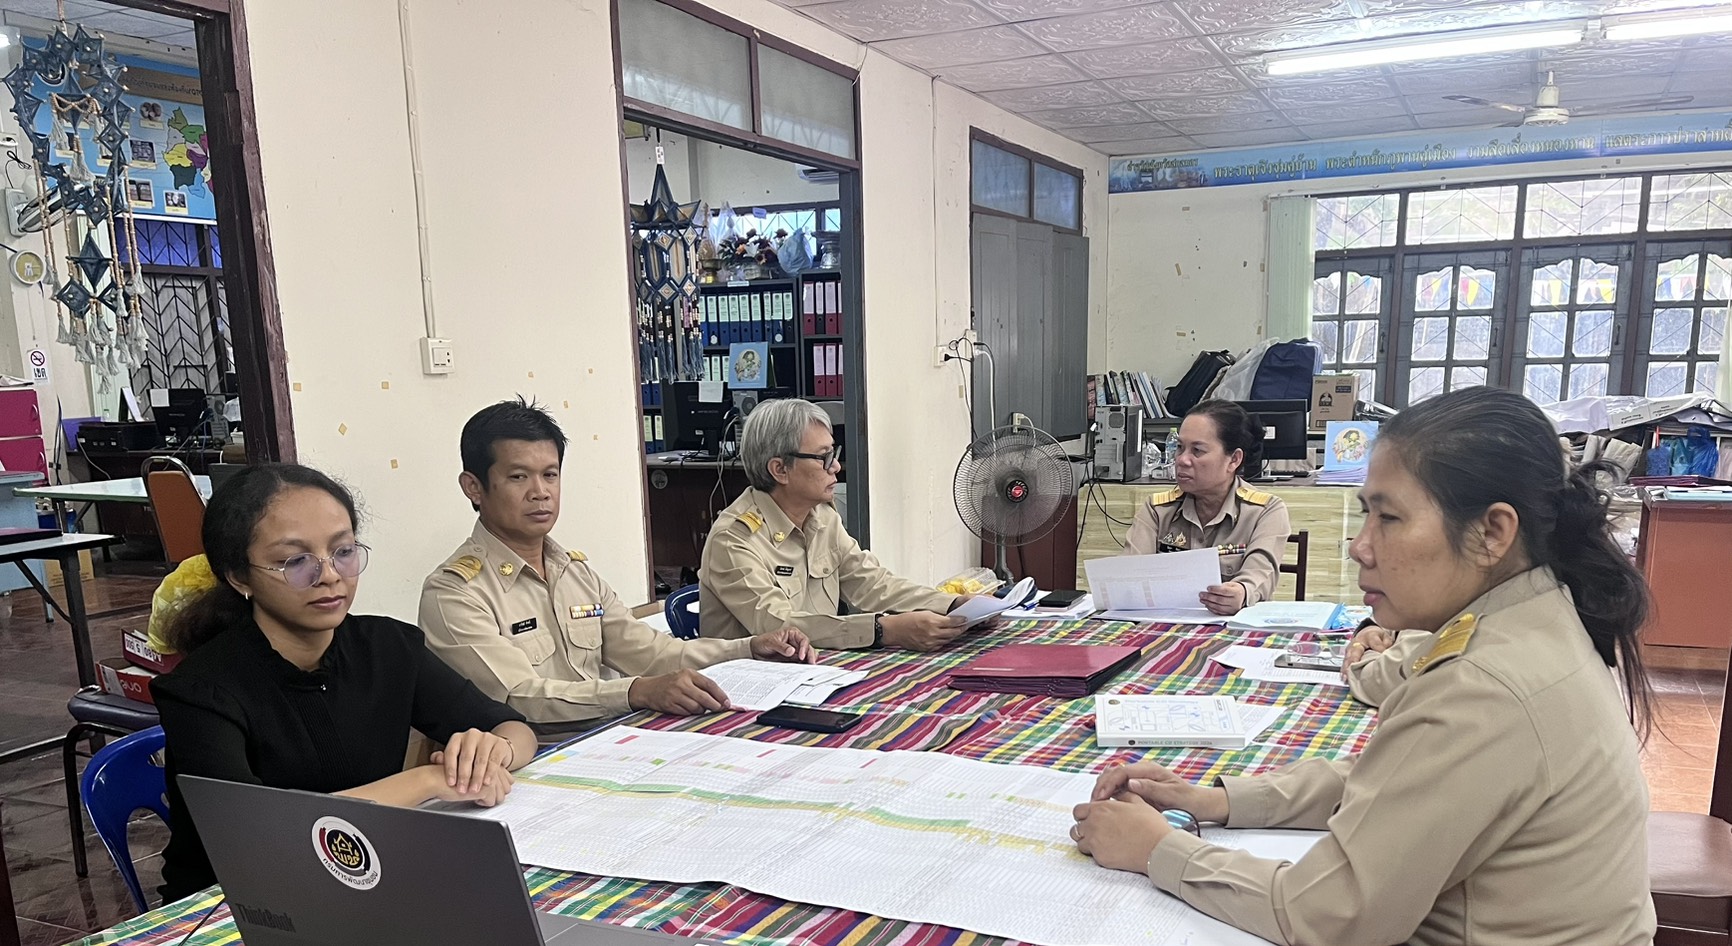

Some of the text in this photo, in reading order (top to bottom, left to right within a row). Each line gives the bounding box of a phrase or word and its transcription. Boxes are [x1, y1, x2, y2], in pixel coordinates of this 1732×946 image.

[323, 858, 378, 886] กรมการพัฒนาชุมชน
[235, 903, 296, 933] ThinkBook
